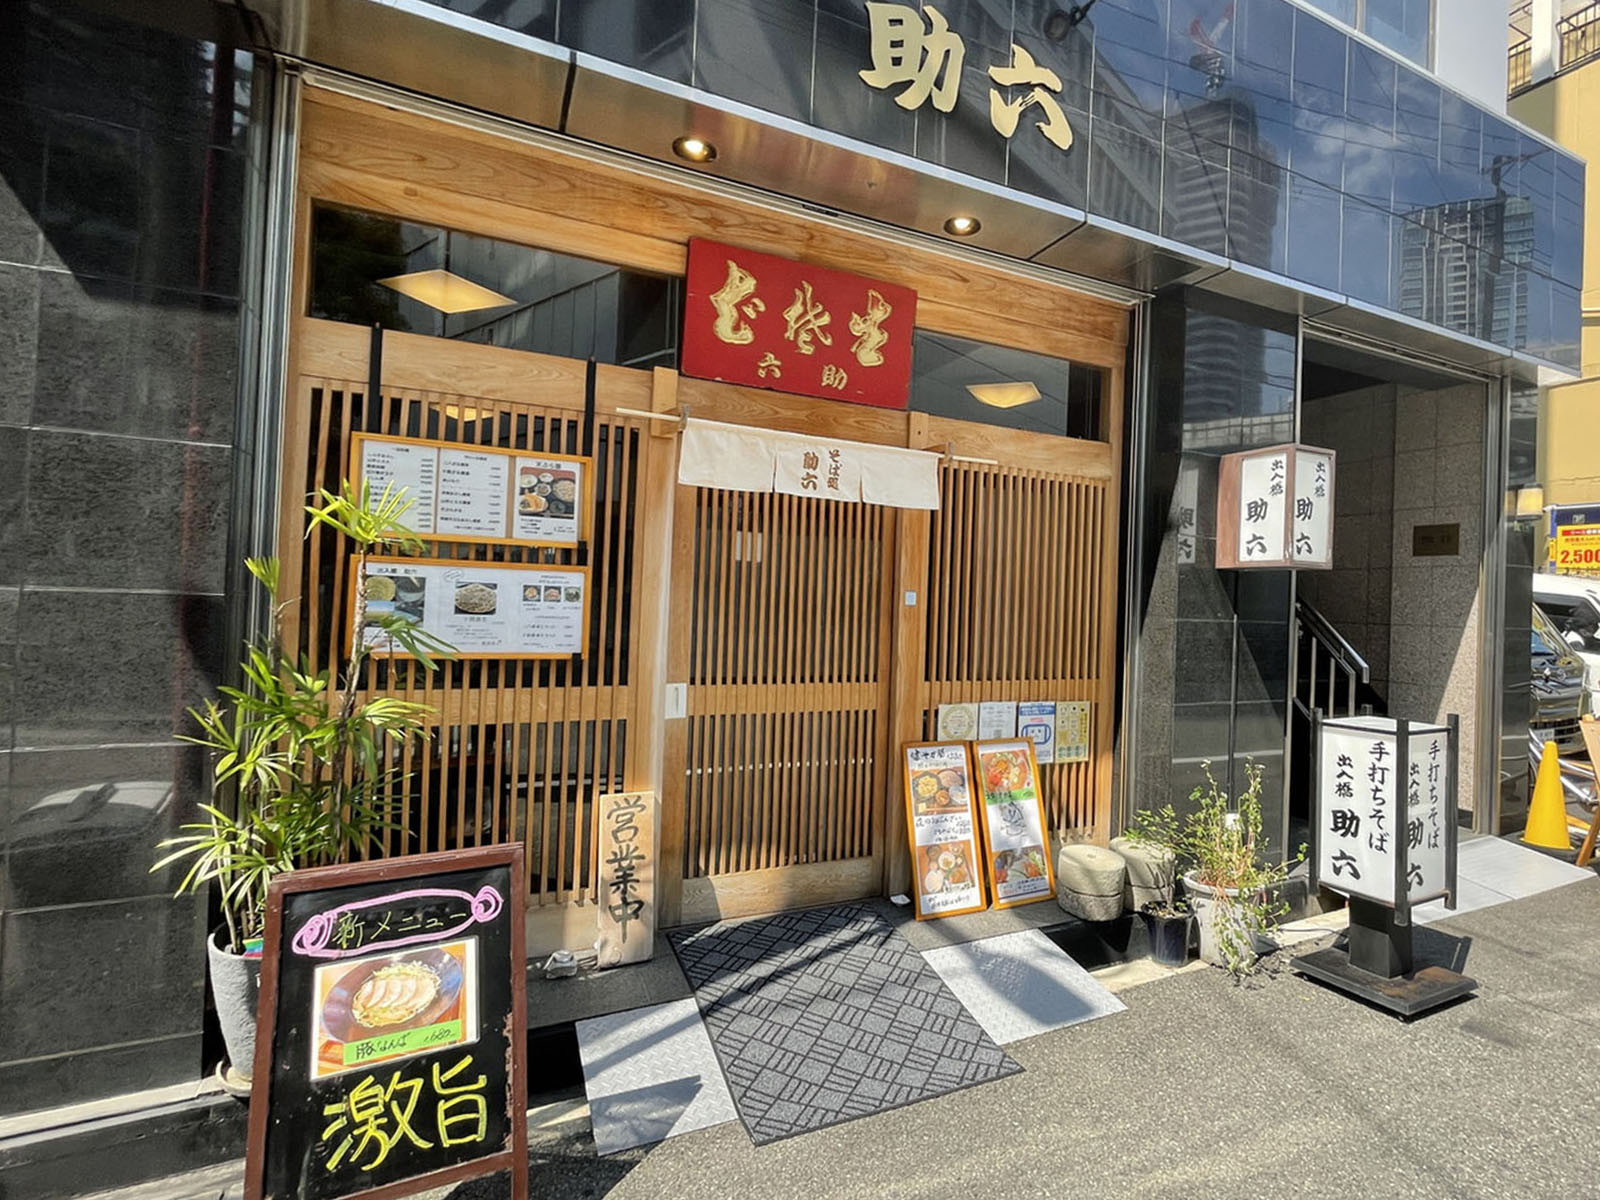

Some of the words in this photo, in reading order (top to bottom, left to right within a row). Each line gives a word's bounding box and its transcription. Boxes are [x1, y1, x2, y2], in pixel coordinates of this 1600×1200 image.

[858, 2, 1074, 151] 助六
[801, 451, 820, 491] 助六
[1245, 497, 1268, 557] 助六
[1295, 496, 1314, 556] 助六
[1335, 754, 1354, 798] 出入橋
[1367, 740, 1390, 854] 手打ちそば
[1427, 739, 1441, 849] 手打ちそば
[606, 795, 647, 944] 営業中
[1330, 808, 1361, 881] 助六
[332, 911, 467, 949] 新メニュー
[322, 1055, 488, 1173] 激旨
